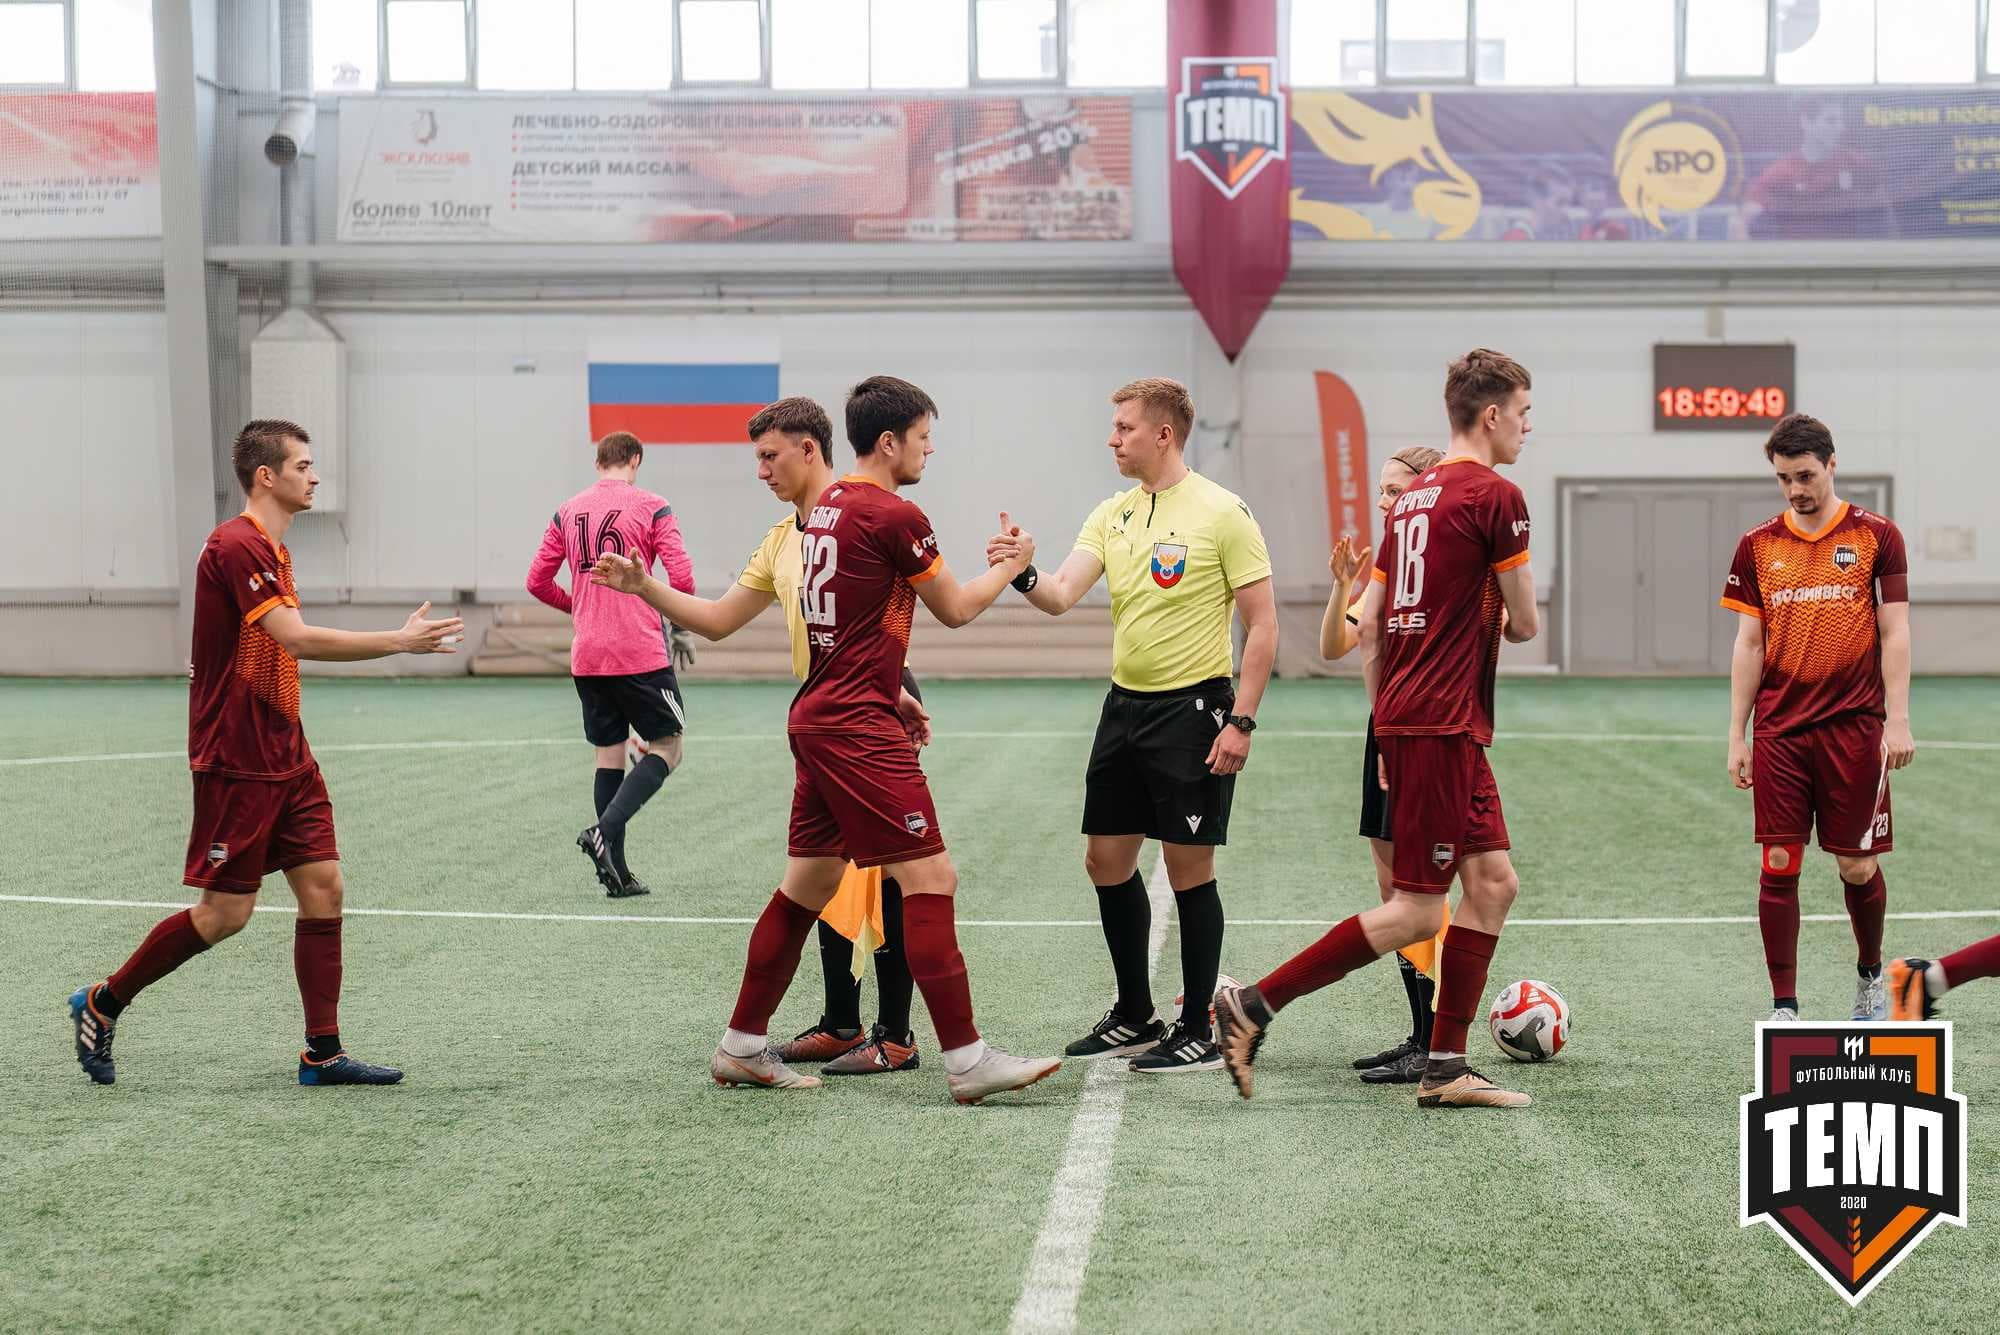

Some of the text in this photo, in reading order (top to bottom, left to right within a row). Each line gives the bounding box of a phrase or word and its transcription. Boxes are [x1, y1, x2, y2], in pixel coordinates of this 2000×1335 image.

[512, 113, 803, 129] ЛЕЧЕБНО-ОЗДОРОВИТЕЛЬНЫЙ
[1187, 97, 1275, 144] ТЕМП
[512, 160, 692, 176] ДЕТСКИЙ МАССАЖ
[352, 199, 421, 219] более
[1658, 386, 1786, 417] 18:59:49
[575, 510, 625, 573] 16
[1393, 512, 1429, 610] 18
[1836, 552, 1857, 563] ТЕМП
[802, 533, 838, 627] 22
[1876, 812, 1889, 838] 23
